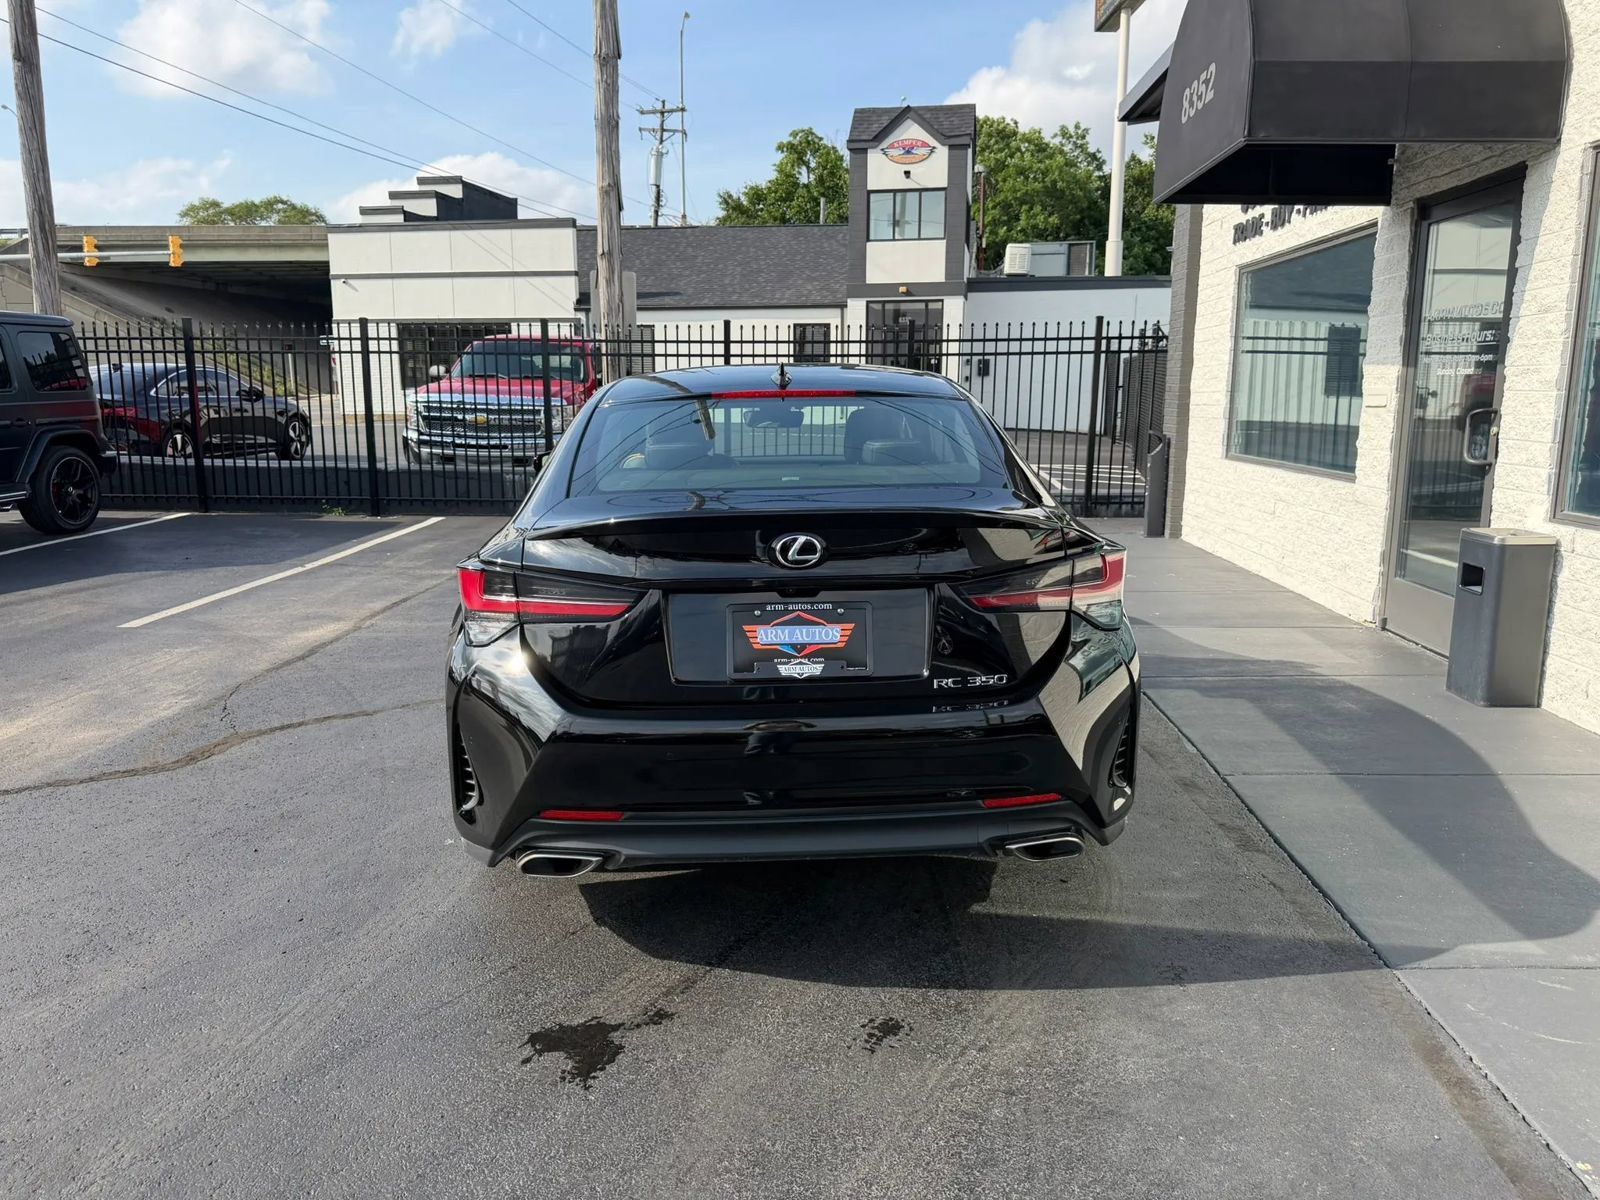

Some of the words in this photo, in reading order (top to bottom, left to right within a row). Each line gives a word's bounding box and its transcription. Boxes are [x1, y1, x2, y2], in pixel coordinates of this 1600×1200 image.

[1182, 62, 1216, 124] 8352
[1233, 213, 1264, 245] TRADE
[766, 602, 832, 611] arm-autos.com
[757, 628, 789, 641] ARM
[792, 627, 841, 641] AUTOS
[933, 677, 962, 689] RC
[967, 674, 1008, 687] 350
